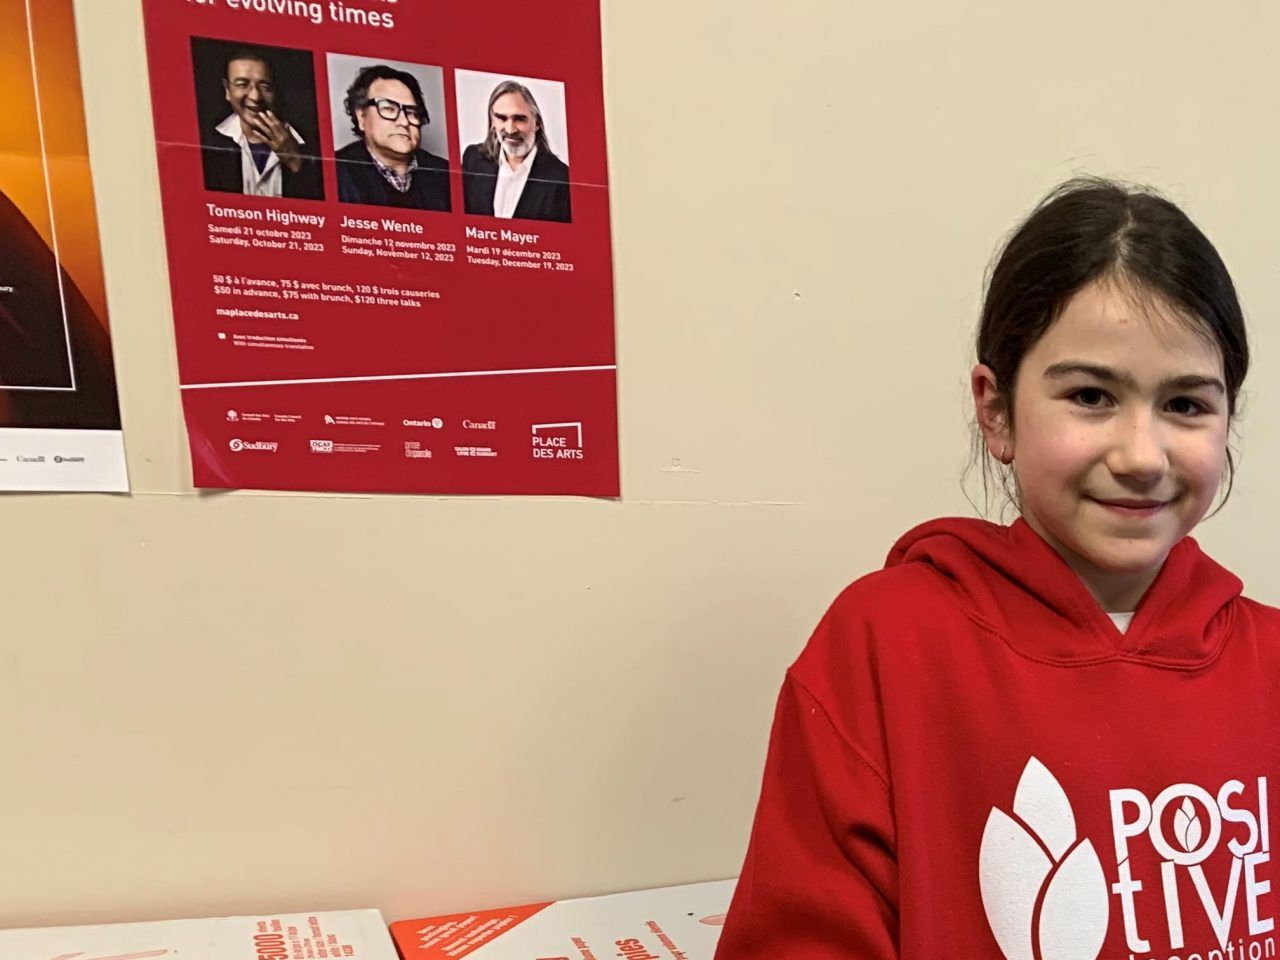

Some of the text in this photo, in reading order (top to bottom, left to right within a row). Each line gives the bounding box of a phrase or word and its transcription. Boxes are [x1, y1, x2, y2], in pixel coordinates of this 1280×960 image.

[329, 3, 394, 28] times
[206, 203, 325, 228] Tomson Highway
[208, 224, 311, 240] Samedi 21 octobre 2023
[341, 216, 424, 234] Jesse Wente
[209, 235, 251, 248] Saturday,
[253, 239, 286, 249] October
[304, 243, 324, 251] 2023
[341, 235, 456, 252] Dimanche 12 novembre 2023
[466, 226, 539, 245] Marc Mayer
[342, 246, 454, 262] Sunday, November 12, 2023
[467, 246, 561, 261] Mardi 19 décembre 2023
[467, 256, 574, 272] Tuesday, December 19, 2023
[216, 308, 298, 320] maplacedesarts.ca
[403, 419, 432, 427] Ontario
[532, 437, 566, 447] PLACE
[533, 449, 583, 459] DES ARTS
